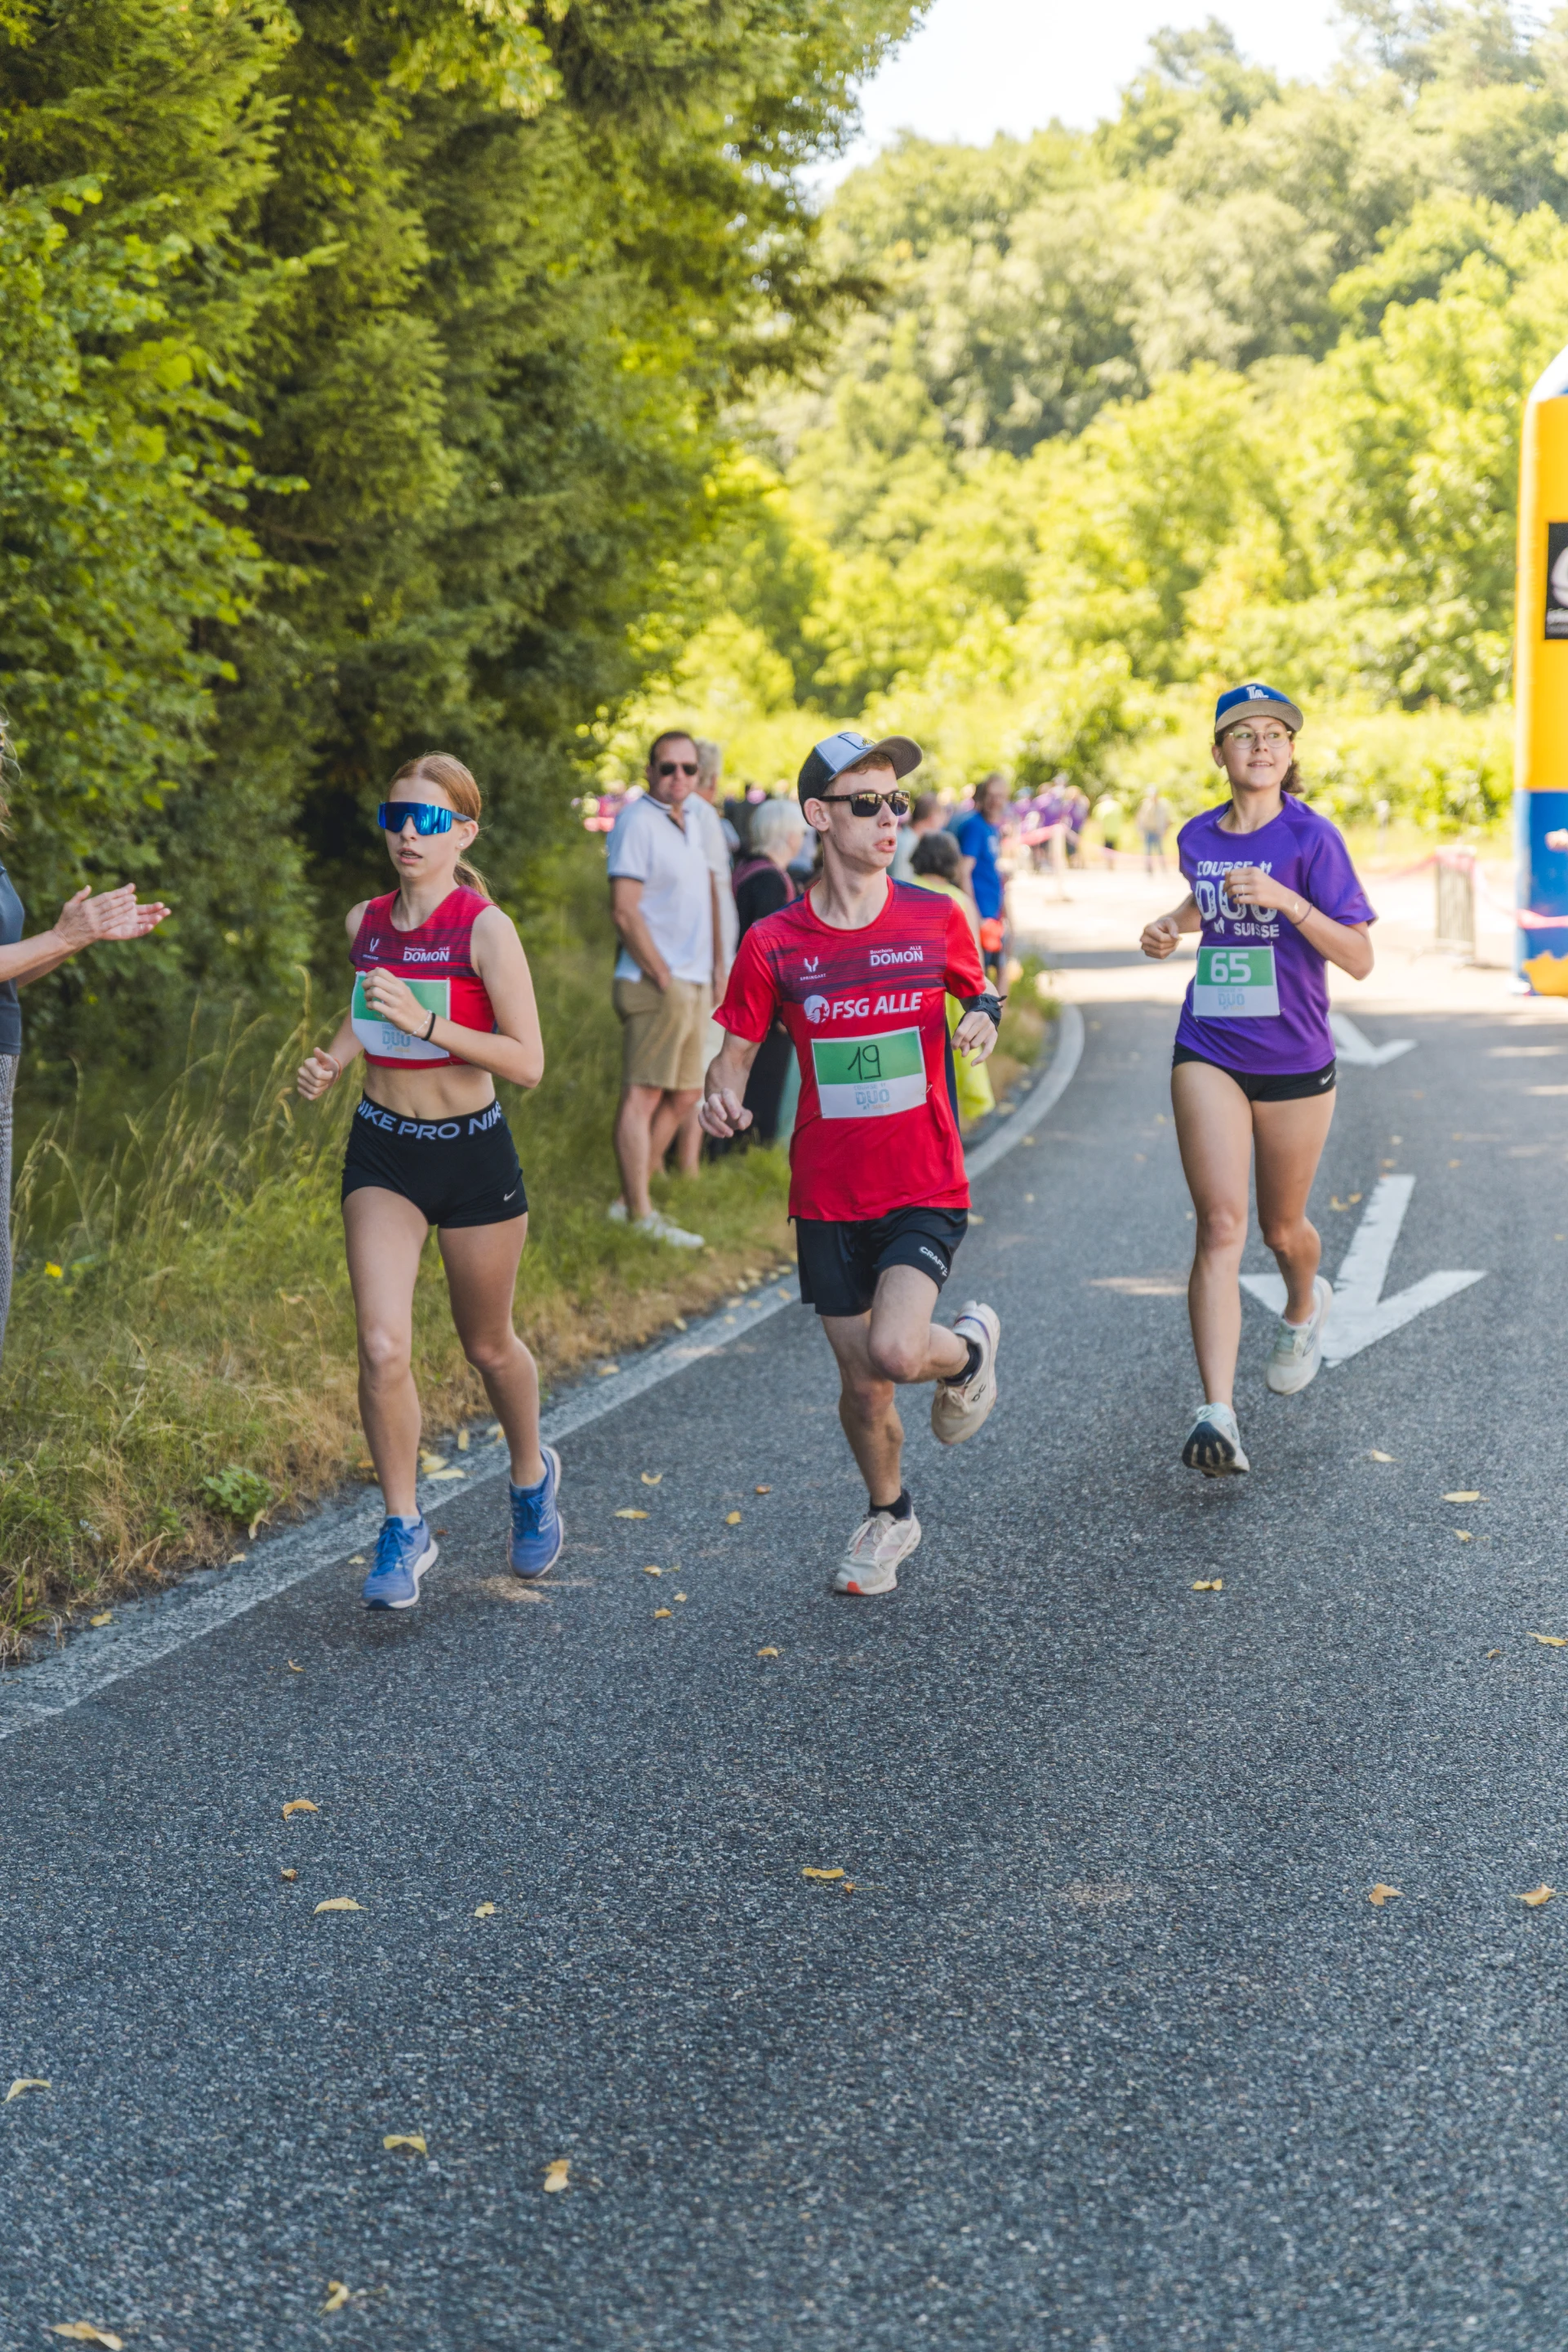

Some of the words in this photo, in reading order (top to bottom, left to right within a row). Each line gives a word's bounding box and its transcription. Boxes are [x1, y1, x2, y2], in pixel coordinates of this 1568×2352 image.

[1233, 922, 1280, 938] SUISSE
[403, 951, 450, 962] DOMON
[871, 951, 923, 966] DOMON
[1210, 952, 1252, 983] 65
[831, 998, 870, 1020] FSG
[873, 991, 923, 1015] ALLE
[1218, 993, 1245, 1006] DUO
[847, 1045, 881, 1080] 19
[855, 1089, 890, 1106] DUO
[358, 1099, 398, 1133] NIKE
[397, 1120, 462, 1141] PRO
[920, 1245, 946, 1271] CRAFT
